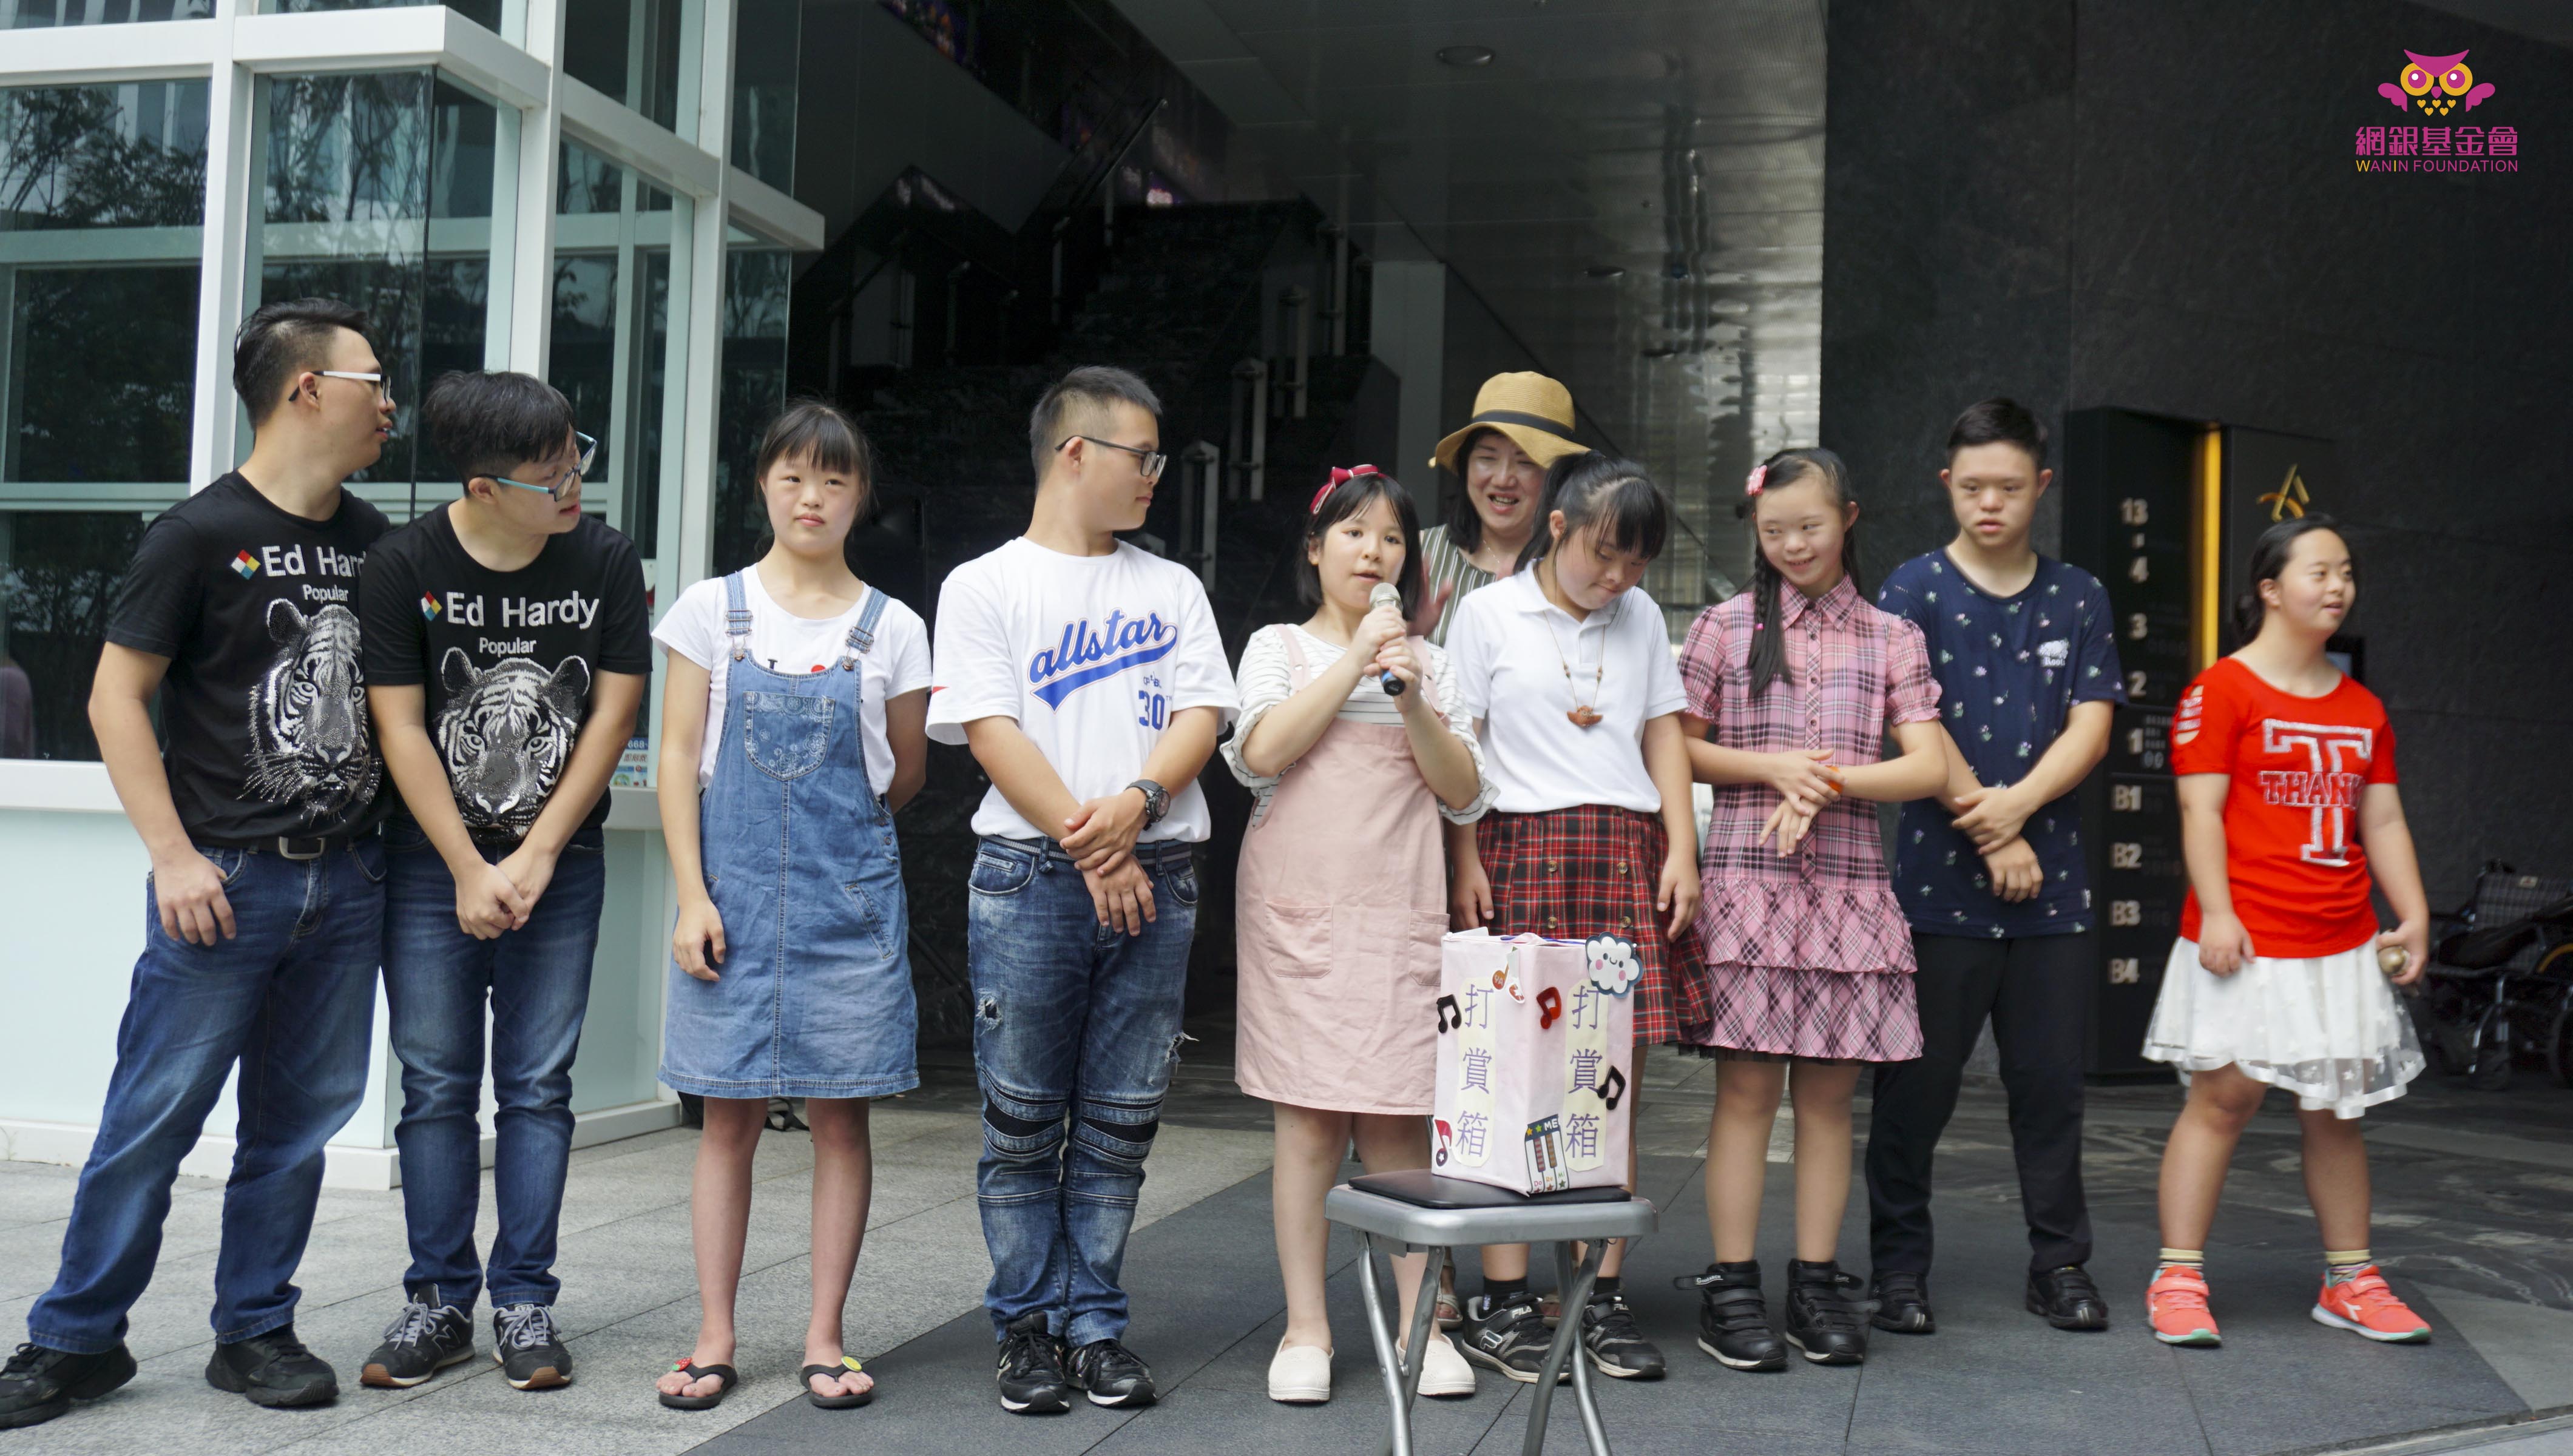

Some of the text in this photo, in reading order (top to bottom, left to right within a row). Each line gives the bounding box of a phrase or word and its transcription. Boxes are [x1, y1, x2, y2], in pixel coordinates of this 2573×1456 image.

[2120, 497, 2149, 525] 13
[262, 544, 306, 577] Ed
[2128, 556, 2149, 583] 4
[302, 584, 348, 604] Popular
[447, 590, 600, 630] Ed Hardy
[2128, 613, 2148, 639] 3
[479, 637, 537, 658] Popular
[1029, 608, 1178, 684] allstar
[2128, 671, 2147, 698] 2
[1138, 690, 1165, 730] 30
[2127, 727, 2143, 754] 1
[2111, 784, 2142, 811] B1
[2111, 843, 2142, 869] B2
[2109, 900, 2141, 927] B3
[2108, 958, 2140, 985] B4
[1455, 984, 1494, 1158] 打賞箱
[1566, 985, 1603, 1158] 打賞箱
[1512, 1306, 1532, 1319] FILA
